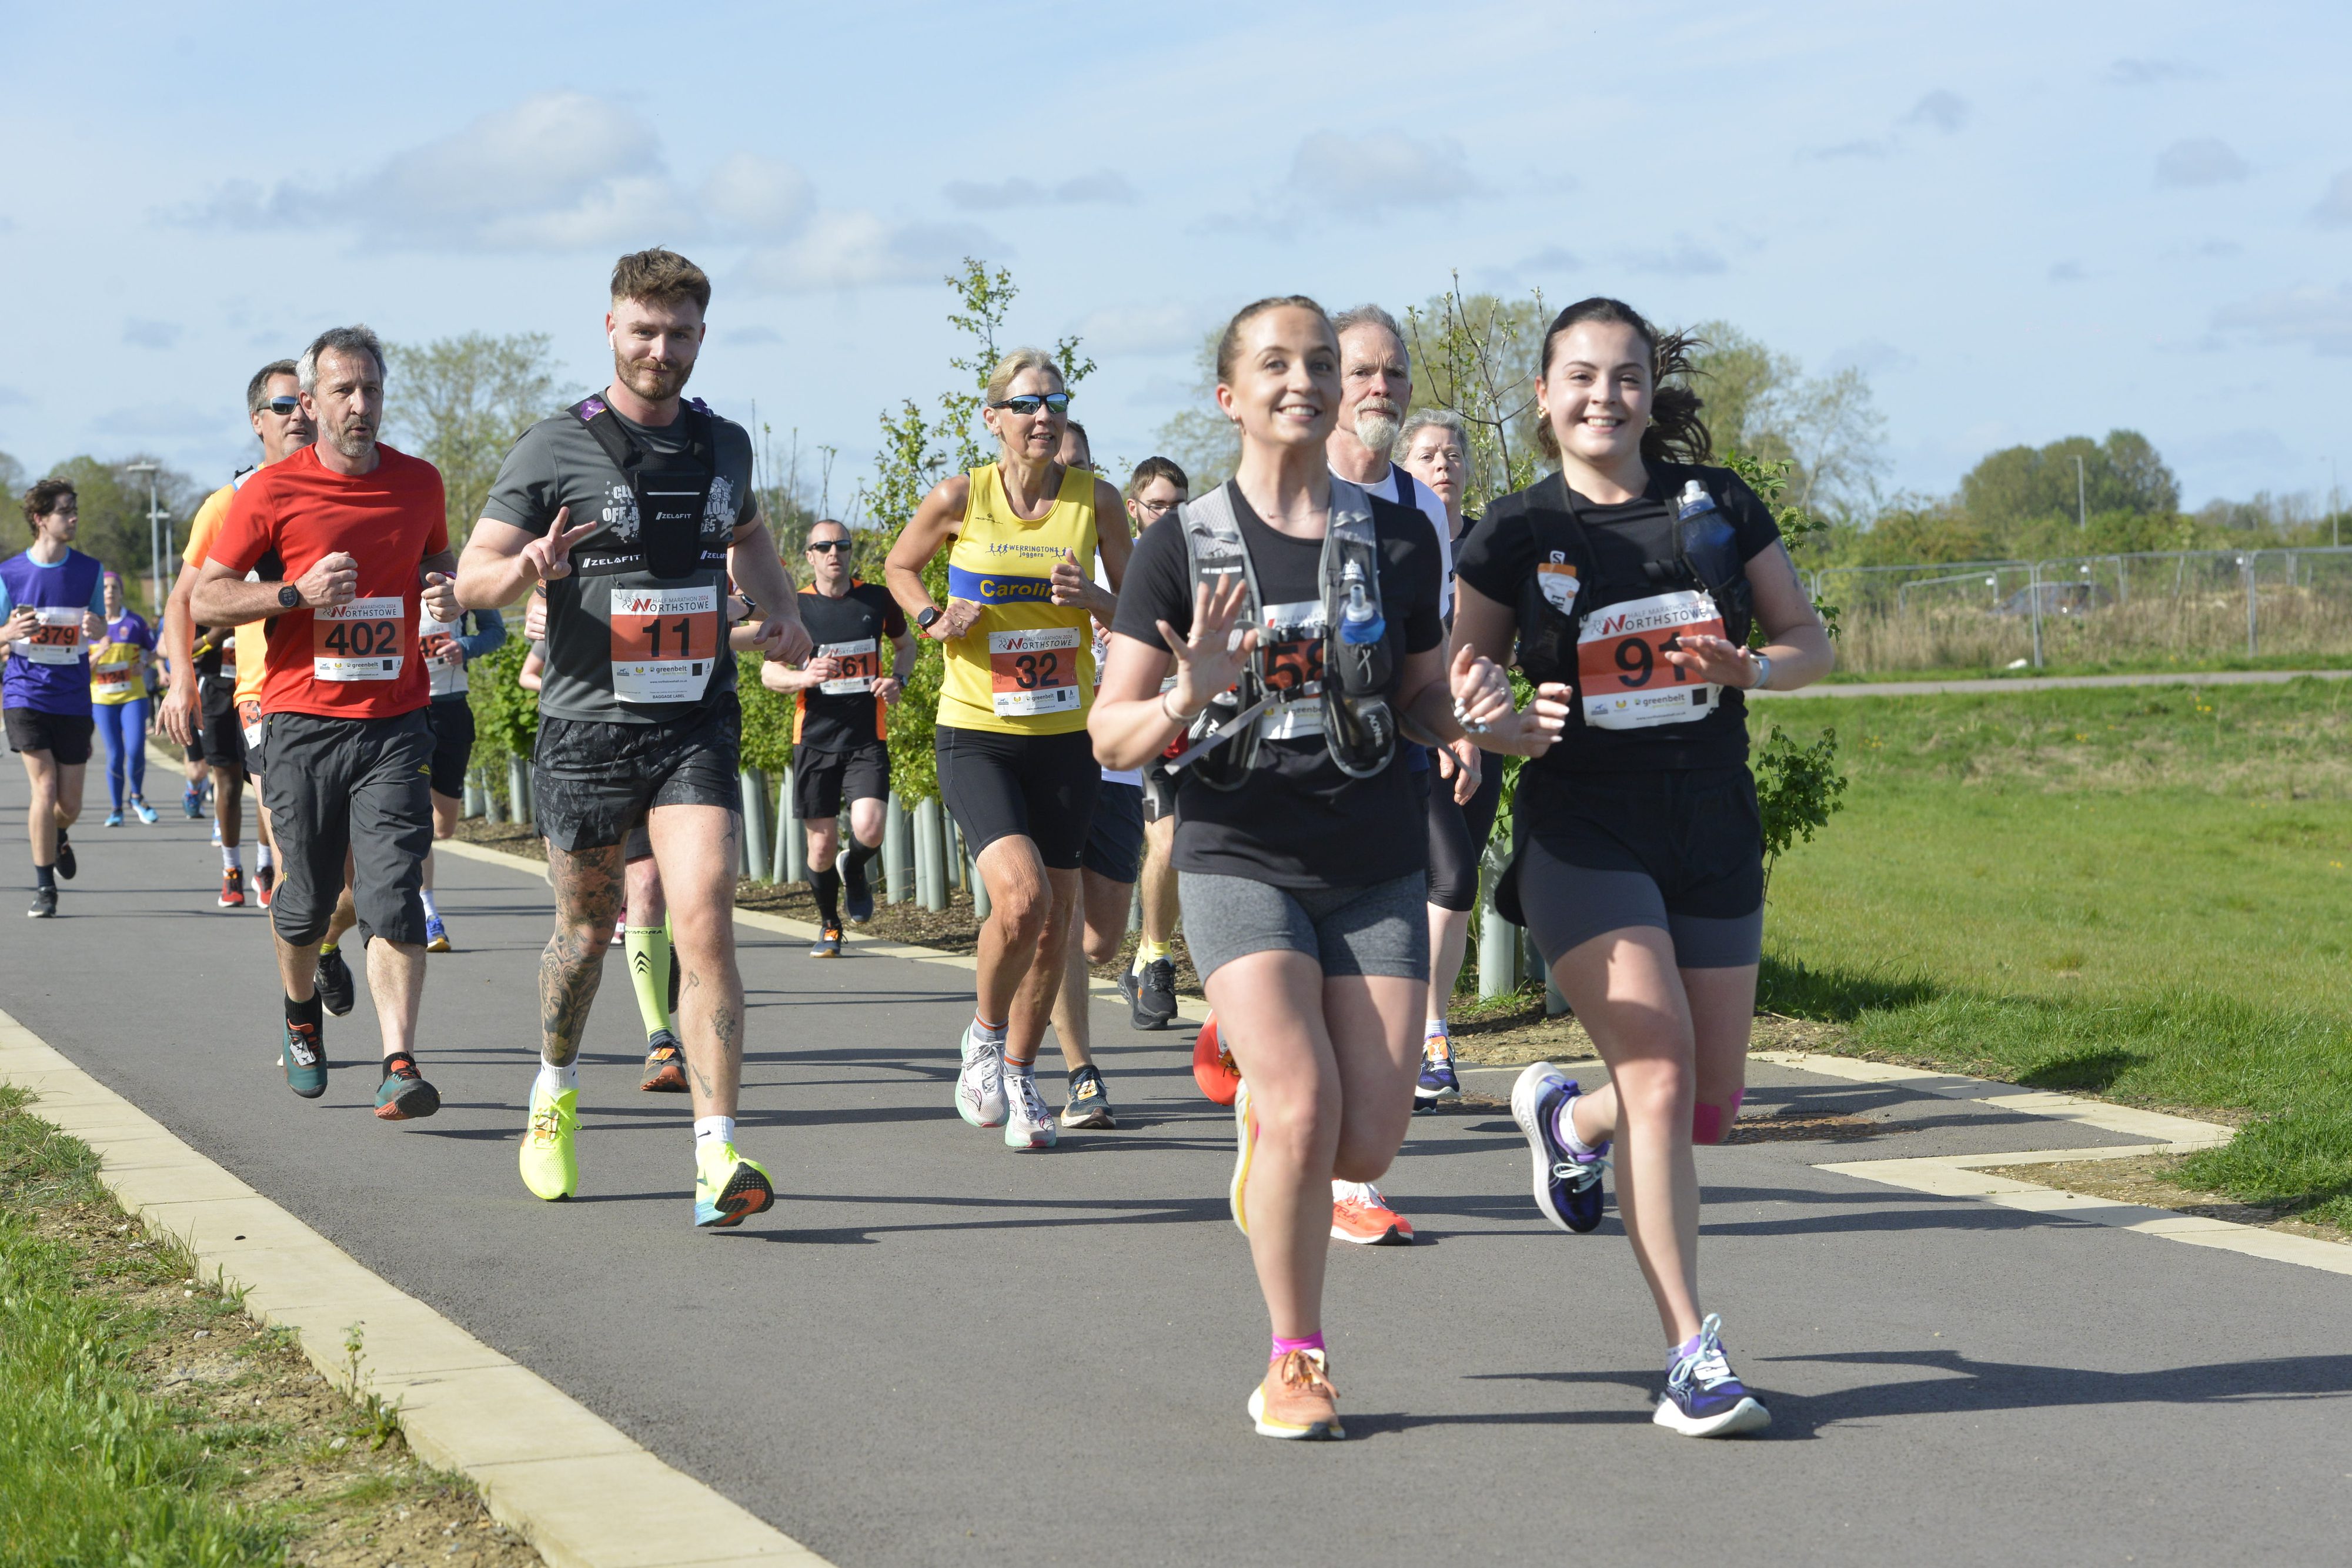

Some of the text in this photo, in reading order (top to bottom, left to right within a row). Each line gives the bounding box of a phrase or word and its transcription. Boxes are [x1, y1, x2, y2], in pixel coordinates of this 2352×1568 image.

[603, 507, 626, 523] OFF
[1010, 544, 1054, 553] WERRINGTON
[591, 554, 641, 566] ZELAFIT
[330, 606, 396, 617] NORTHSTOWE
[632, 599, 709, 612] NORTHSTOWE
[1648, 605, 1687, 614] MARATHON
[1603, 609, 1706, 635] NORTHSTOWE
[37, 627, 75, 644] 379
[325, 621, 397, 656] 402
[643, 618, 689, 657] 11
[1007, 637, 1072, 650] NORTHSTOWE
[1615, 631, 1686, 687] 91
[1015, 653, 1060, 688] 32
[1031, 693, 1054, 701] greenbelt
[1643, 693, 1685, 706] greenbelt
